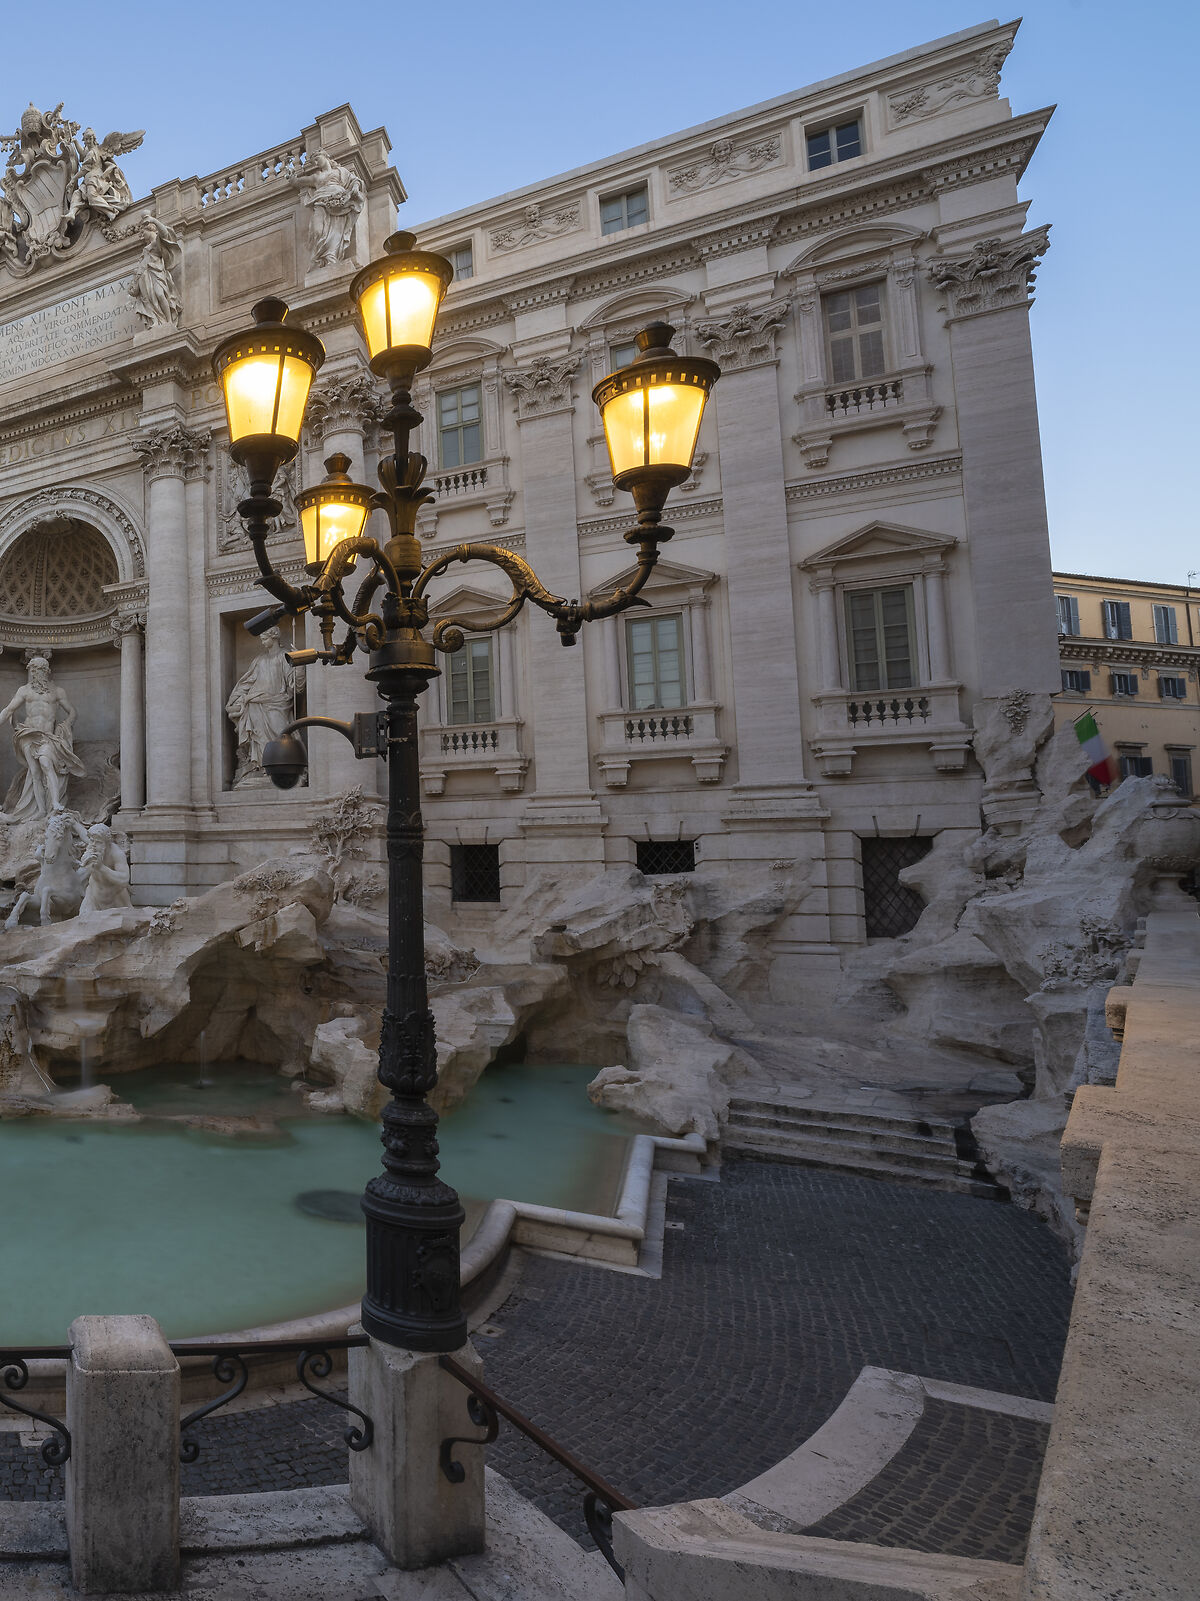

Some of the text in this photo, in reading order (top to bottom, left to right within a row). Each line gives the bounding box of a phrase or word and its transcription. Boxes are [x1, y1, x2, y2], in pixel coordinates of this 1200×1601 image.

[8, 308, 90, 346] AQVAM VIRGINEM
[18, 338, 68, 362] MAGNIFICO
[71, 321, 113, 343] ORNAVIT
